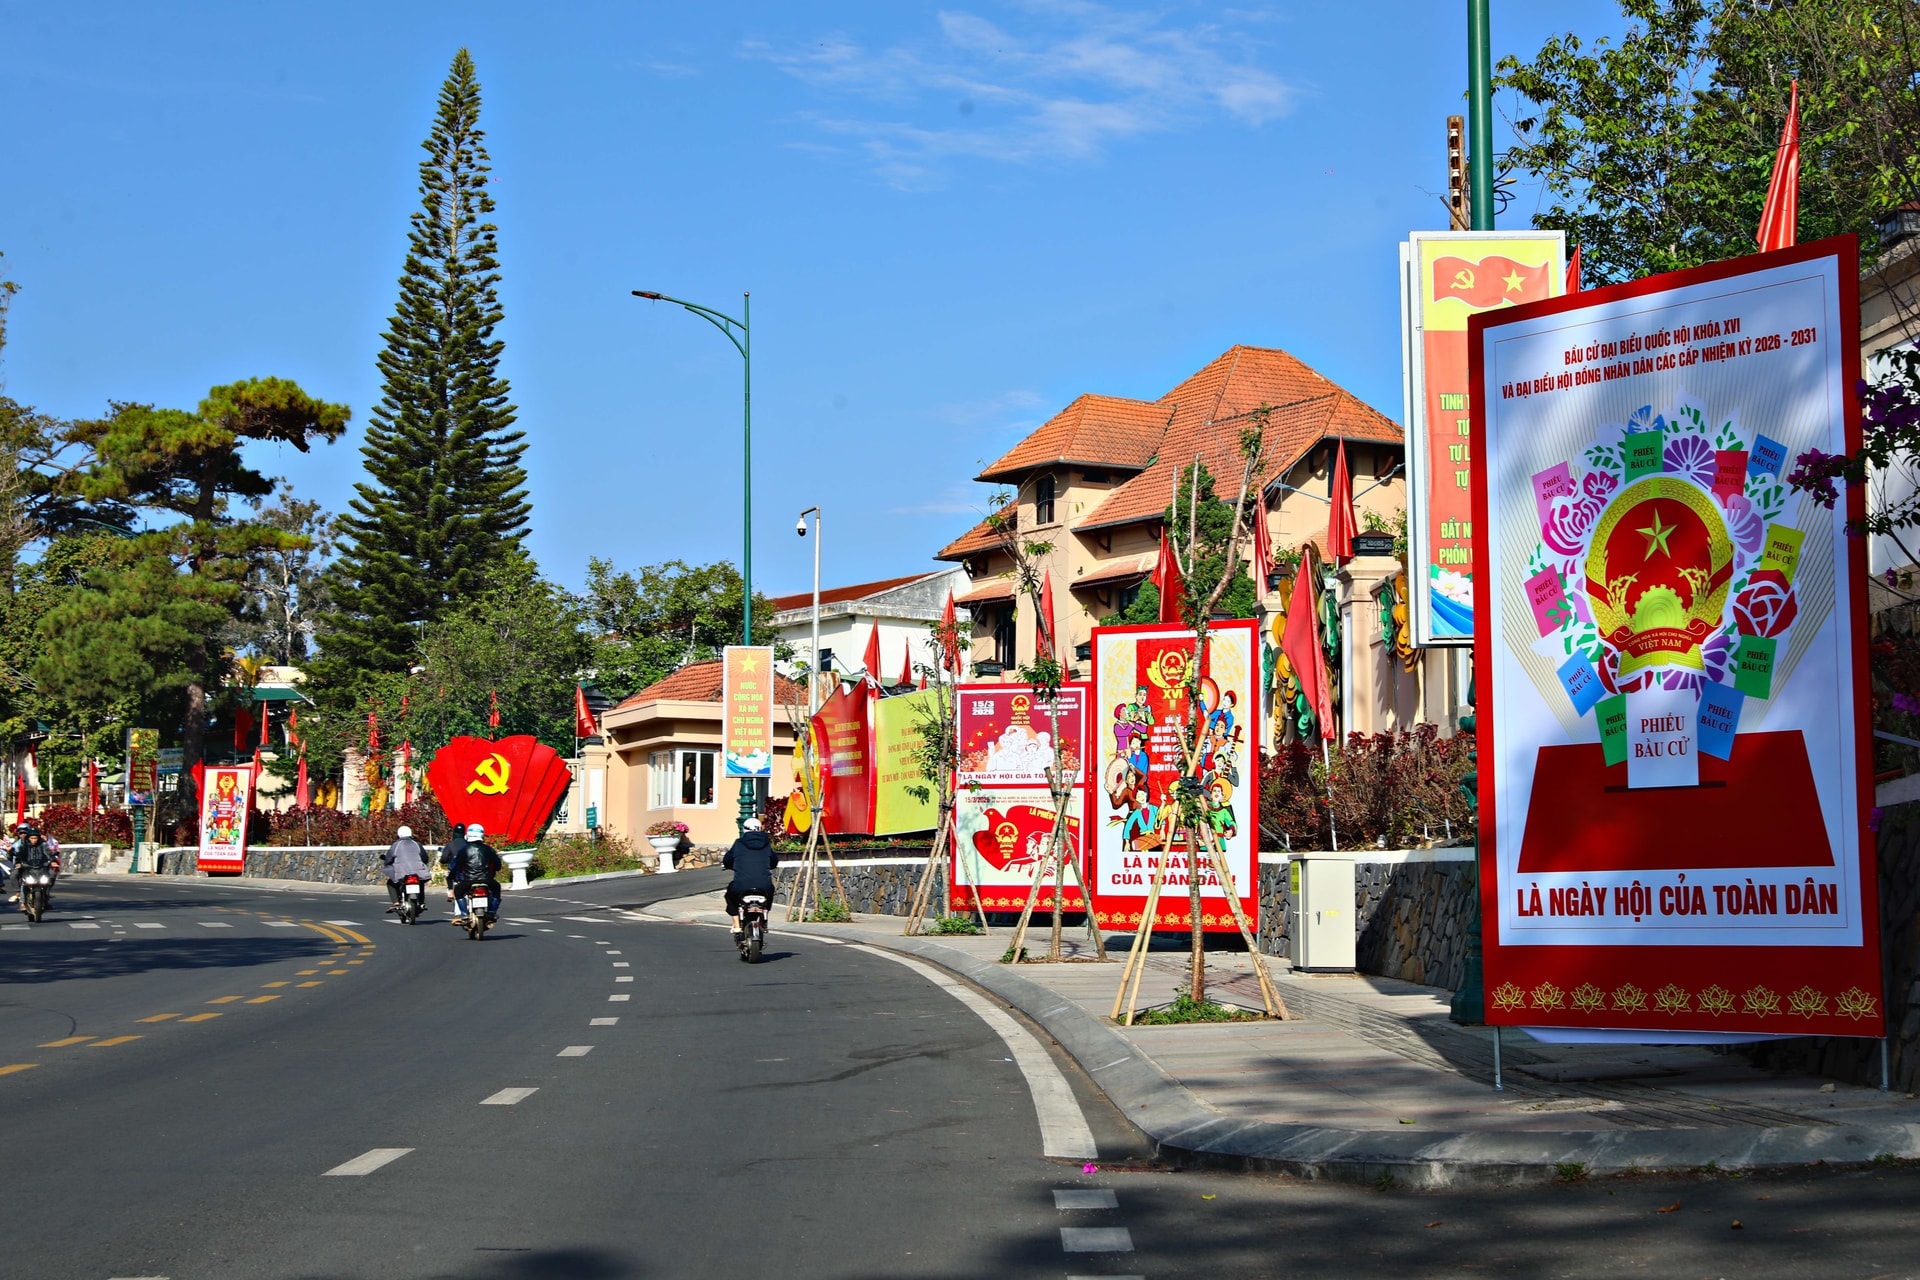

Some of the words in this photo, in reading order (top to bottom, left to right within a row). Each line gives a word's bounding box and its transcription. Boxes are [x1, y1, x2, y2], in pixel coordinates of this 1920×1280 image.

[1565, 344, 1583, 365] BẦU
[1586, 340, 1599, 361] CỬ
[1602, 343, 1617, 360] ĐẠI
[1620, 332, 1642, 354] BIỂU
[1645, 328, 1670, 350] QUỐC
[1674, 326, 1690, 346] HỘI
[1693, 320, 1720, 341] KHÓA
[1724, 318, 1740, 335] XVI
[1502, 381, 1514, 399] VÀ
[1516, 382, 1531, 399] ĐẠI
[1534, 372, 1554, 394] BIỂU
[1558, 371, 1572, 391] HỘI
[1575, 366, 1600, 386] ĐỒNG
[1604, 361, 1630, 381] NHÂN
[1633, 357, 1653, 376] DÂN
[1656, 352, 1676, 371] CÁC
[1679, 345, 1698, 367] CẤP
[1702, 342, 1736, 362] NHIỆM
[1739, 336, 1752, 356] KỲ
[1755, 334, 1780, 353] 2026
[1791, 328, 1816, 346] 2031
[1440, 394, 1464, 410] TINH
[1449, 444, 1463, 464] TỰ
[1633, 446, 1656, 457] PHIẾU
[1759, 446, 1780, 460] PHIẾU
[1630, 457, 1644, 468] BẦU
[1752, 455, 1766, 468] BẦU
[1455, 470, 1470, 490] TỰ
[1542, 475, 1562, 490] PHIẾU
[1542, 488, 1556, 500] BẦU
[1440, 517, 1460, 538] ĐẤT
[1439, 542, 1468, 564] PHỒN
[1772, 540, 1794, 554] PHIẾU
[1766, 550, 1780, 562] BẦU
[1534, 578, 1554, 594] PHIẾU
[1638, 638, 1659, 650] VIỆT
[1662, 639, 1682, 648] NAM
[1746, 650, 1769, 662] PHIẾU
[1568, 664, 1586, 686] PHIẾU
[1162, 689, 1183, 699] XVI
[972, 700, 994, 708] 15/3
[1707, 703, 1733, 720] PHIẾU
[1606, 712, 1625, 725] PHIẾU
[1640, 712, 1685, 733] PHIẾU
[1700, 716, 1718, 730] BẦU
[1634, 738, 1664, 758] BẦU
[1668, 736, 1690, 756] CỬ
[1123, 855, 1142, 868] LÀ
[1112, 870, 1143, 885] CỦA
[1198, 872, 1236, 886] DÂ!
[1518, 882, 1543, 916] LÀ
[1550, 882, 1606, 916] NGÀY
[1615, 880, 1651, 922] HỘI
[1660, 873, 1707, 916] CỦA
[1712, 878, 1777, 915] TOÀN
[1785, 877, 1838, 914] DÂN
